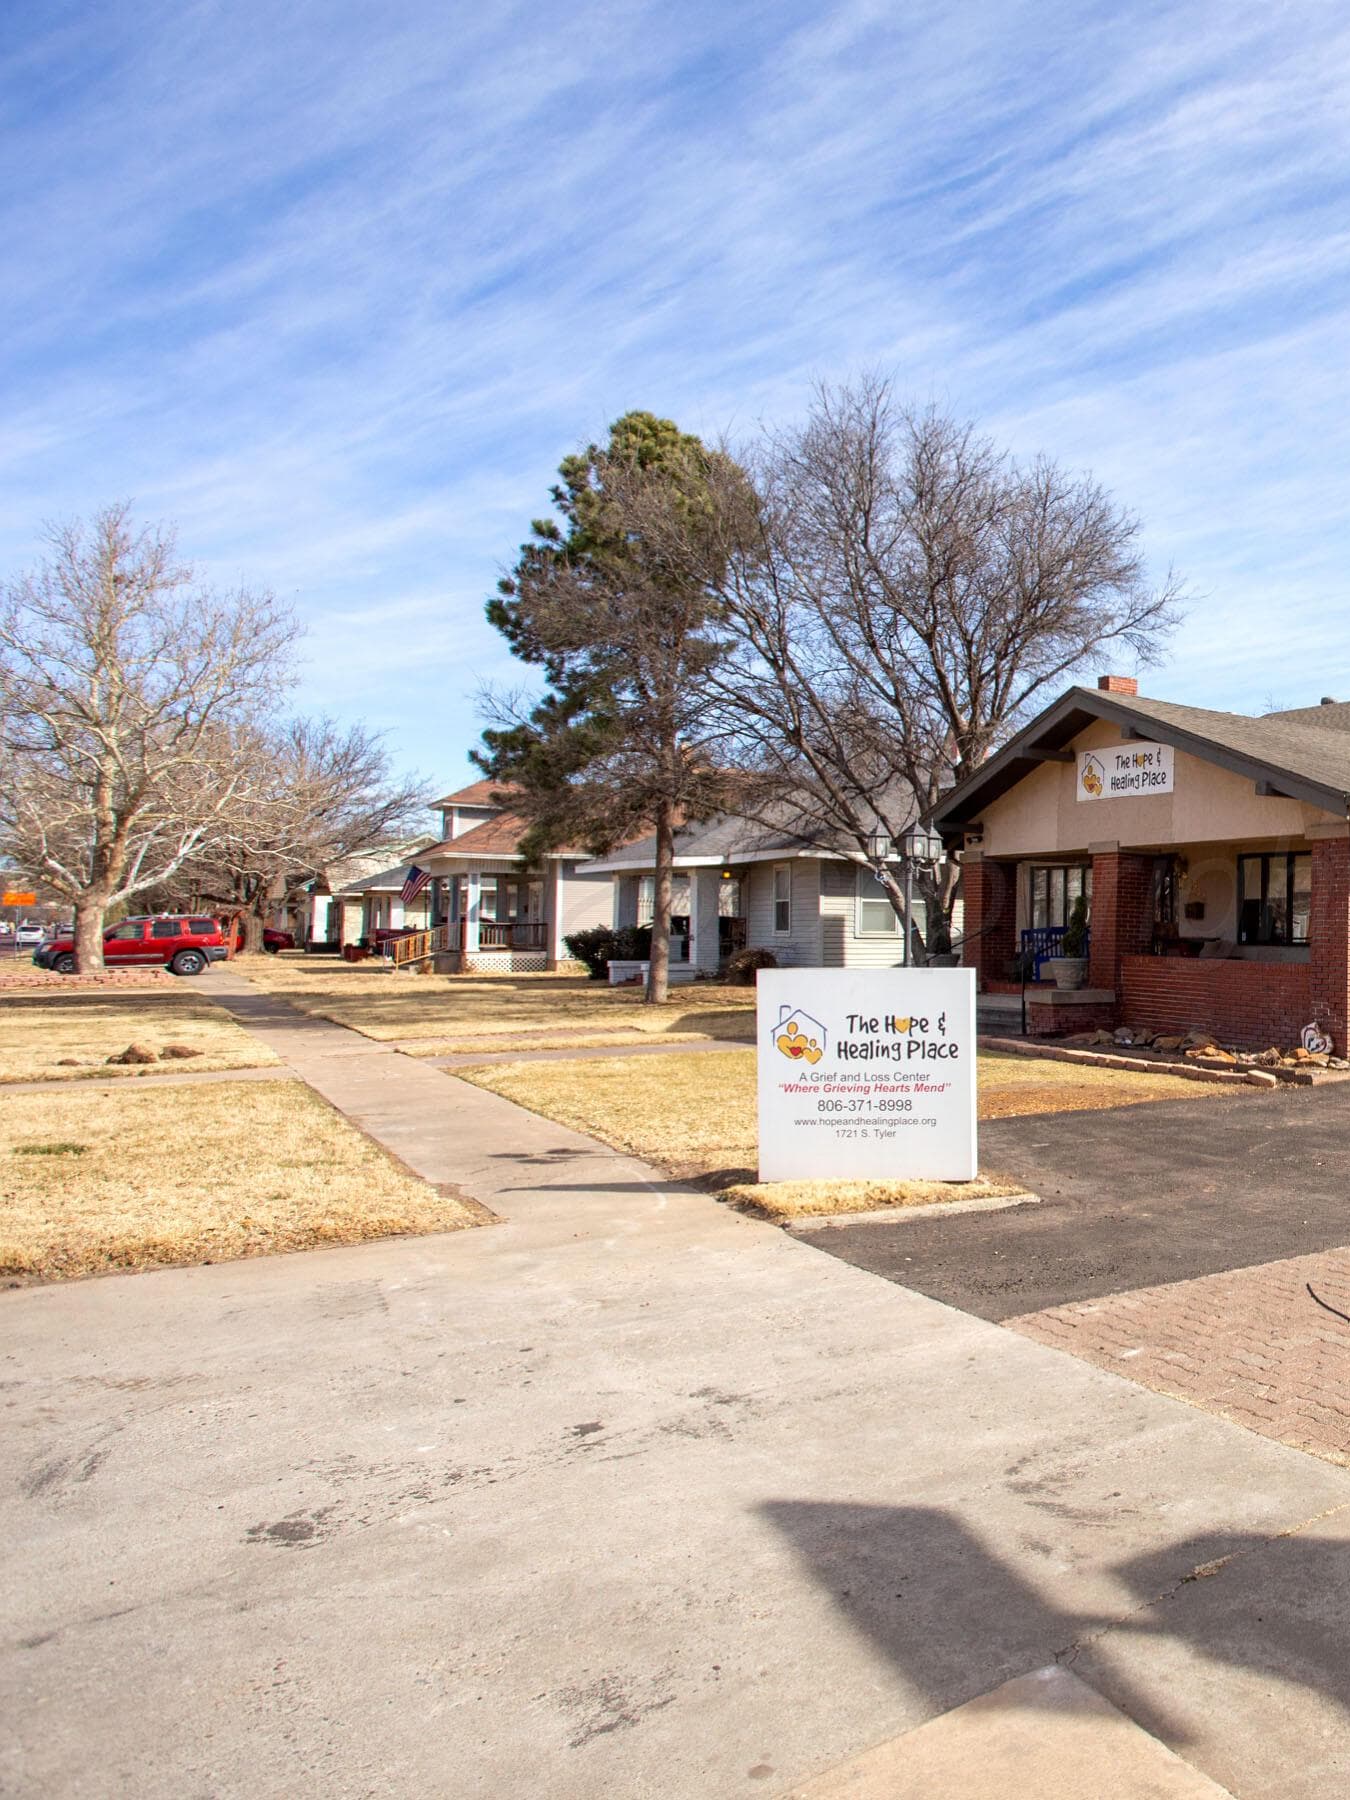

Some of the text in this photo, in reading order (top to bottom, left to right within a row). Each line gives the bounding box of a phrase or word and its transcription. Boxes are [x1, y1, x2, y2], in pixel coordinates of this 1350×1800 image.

[1115, 747, 1161, 770] The Hope &
[1111, 771, 1166, 791] Healing Place
[846, 1012, 946, 1037] The Hope &
[837, 1040, 959, 1062] Healing Place
[799, 1072, 930, 1082] A Grief and Loss Center
[823, 1083, 871, 1096] Grieving
[873, 1083, 910, 1093] Hearts
[817, 1099, 913, 1112] 806-371-8998
[794, 1117, 937, 1128] www.hopeandhealingplace.org
[835, 1129, 897, 1140] 1721 S. Tyler
